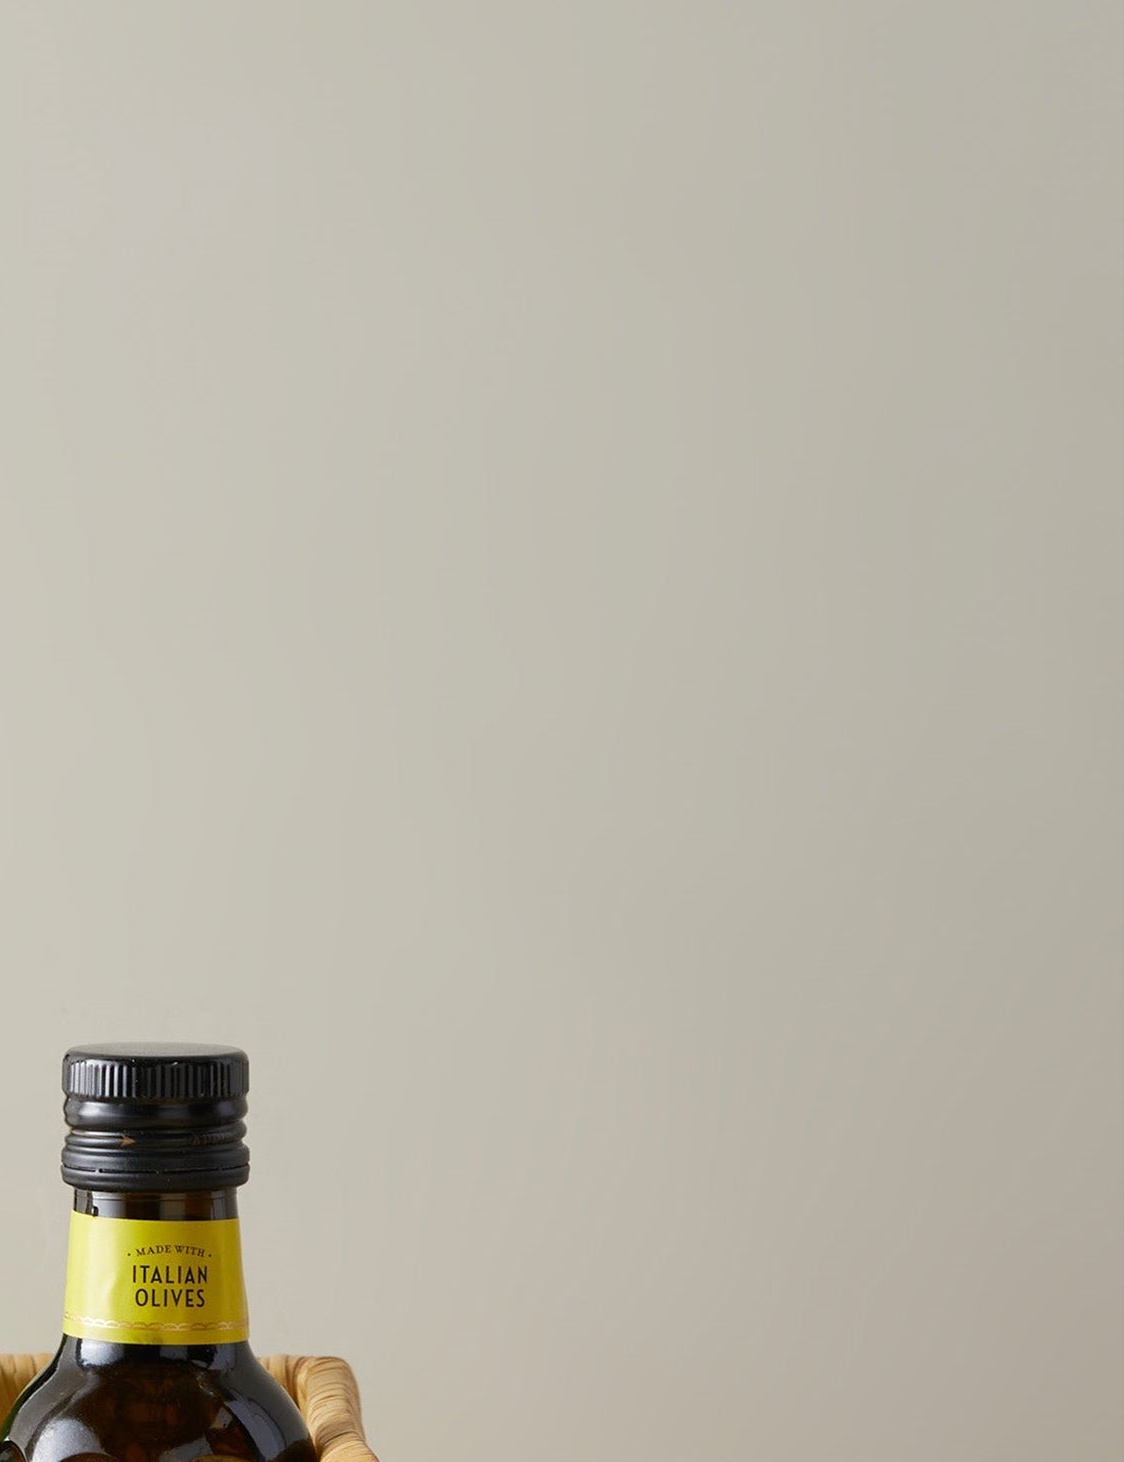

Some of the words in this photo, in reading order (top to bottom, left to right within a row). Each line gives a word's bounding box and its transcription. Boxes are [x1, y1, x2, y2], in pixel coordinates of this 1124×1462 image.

[135, 1245, 171, 1257] MADE
[175, 1245, 205, 1258] WITH
[132, 1264, 208, 1285] ITALIAN
[134, 1288, 205, 1308] OLIVES
